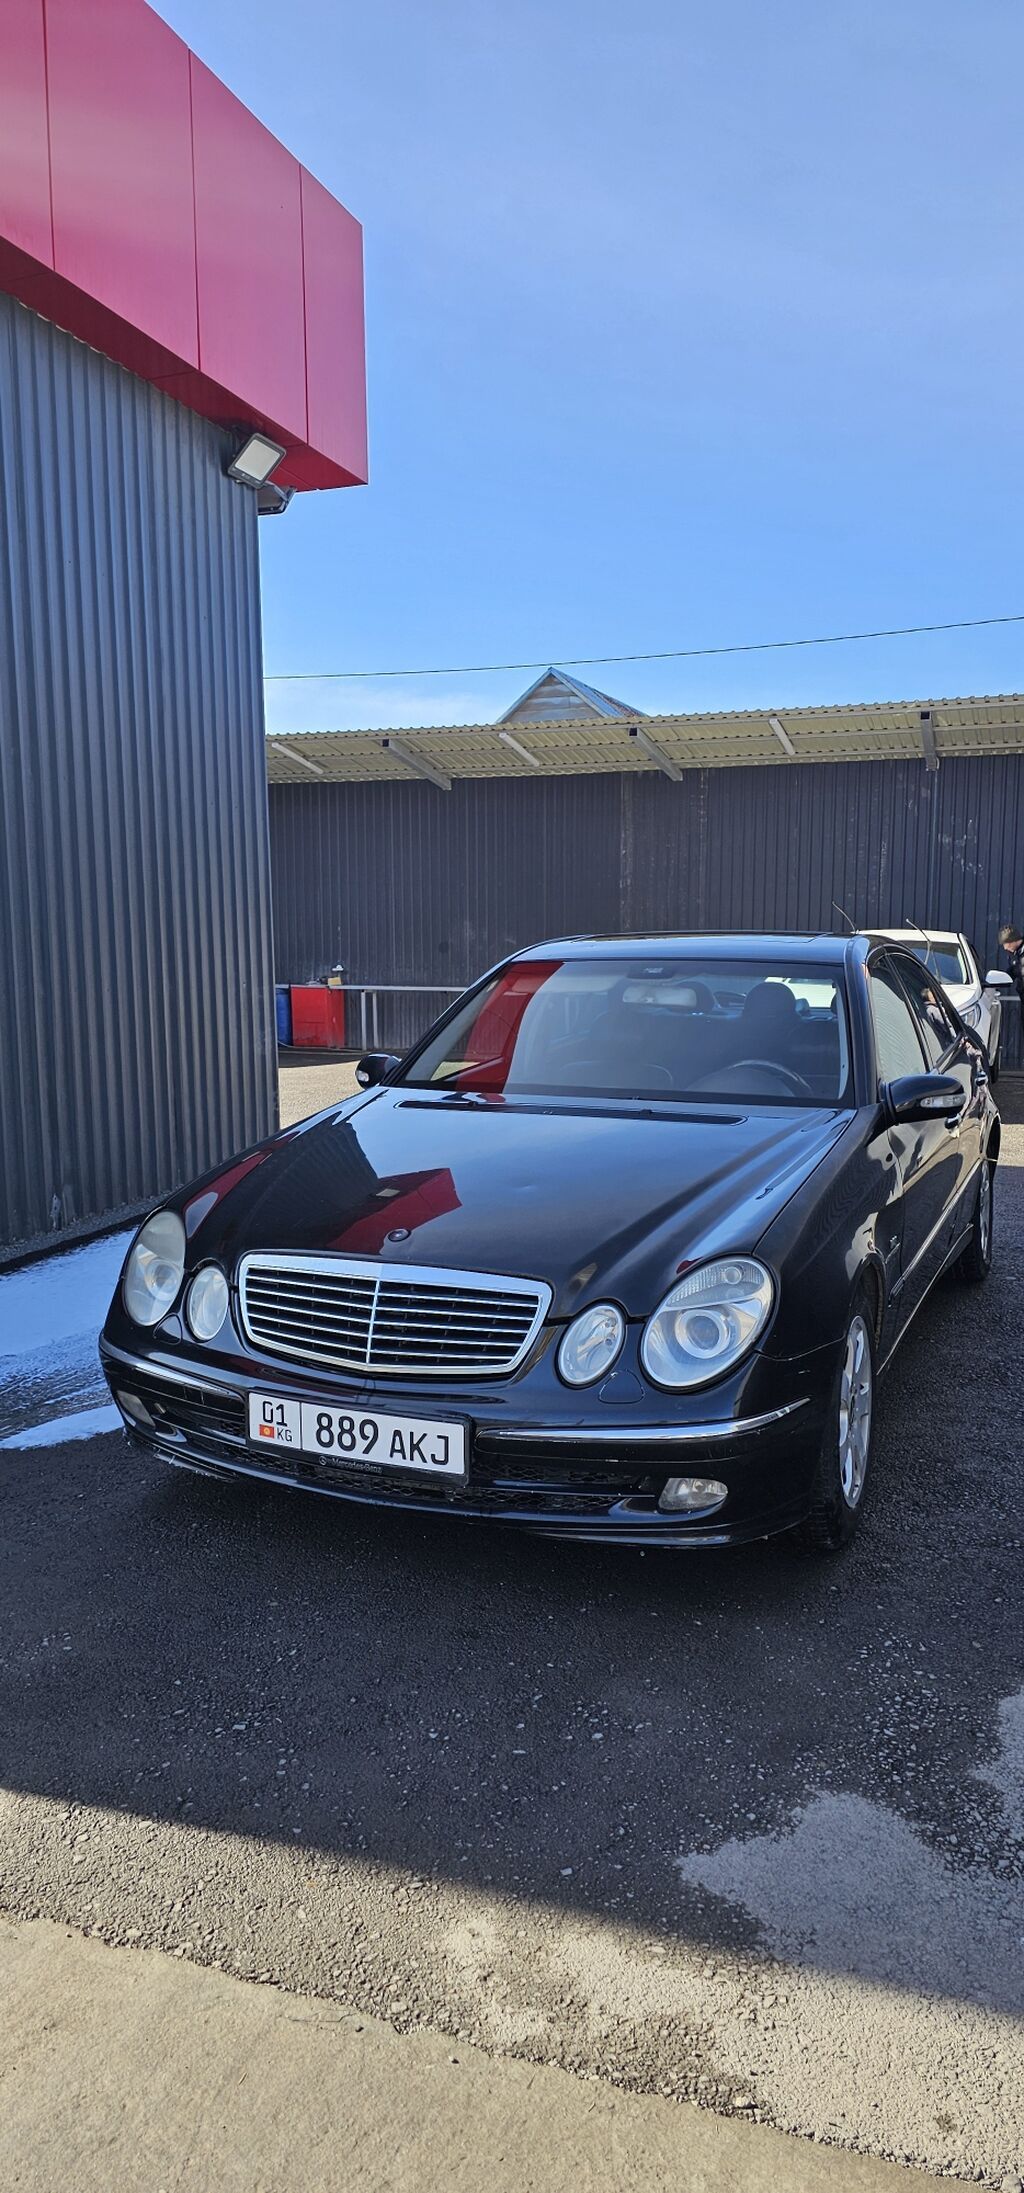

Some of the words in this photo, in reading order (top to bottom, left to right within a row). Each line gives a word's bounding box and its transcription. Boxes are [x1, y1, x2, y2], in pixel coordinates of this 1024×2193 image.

[262, 1400, 288, 1427] 01
[276, 1428, 293, 1443] KG
[315, 1412, 379, 1454] 889
[389, 1429, 449, 1466] AKJ
